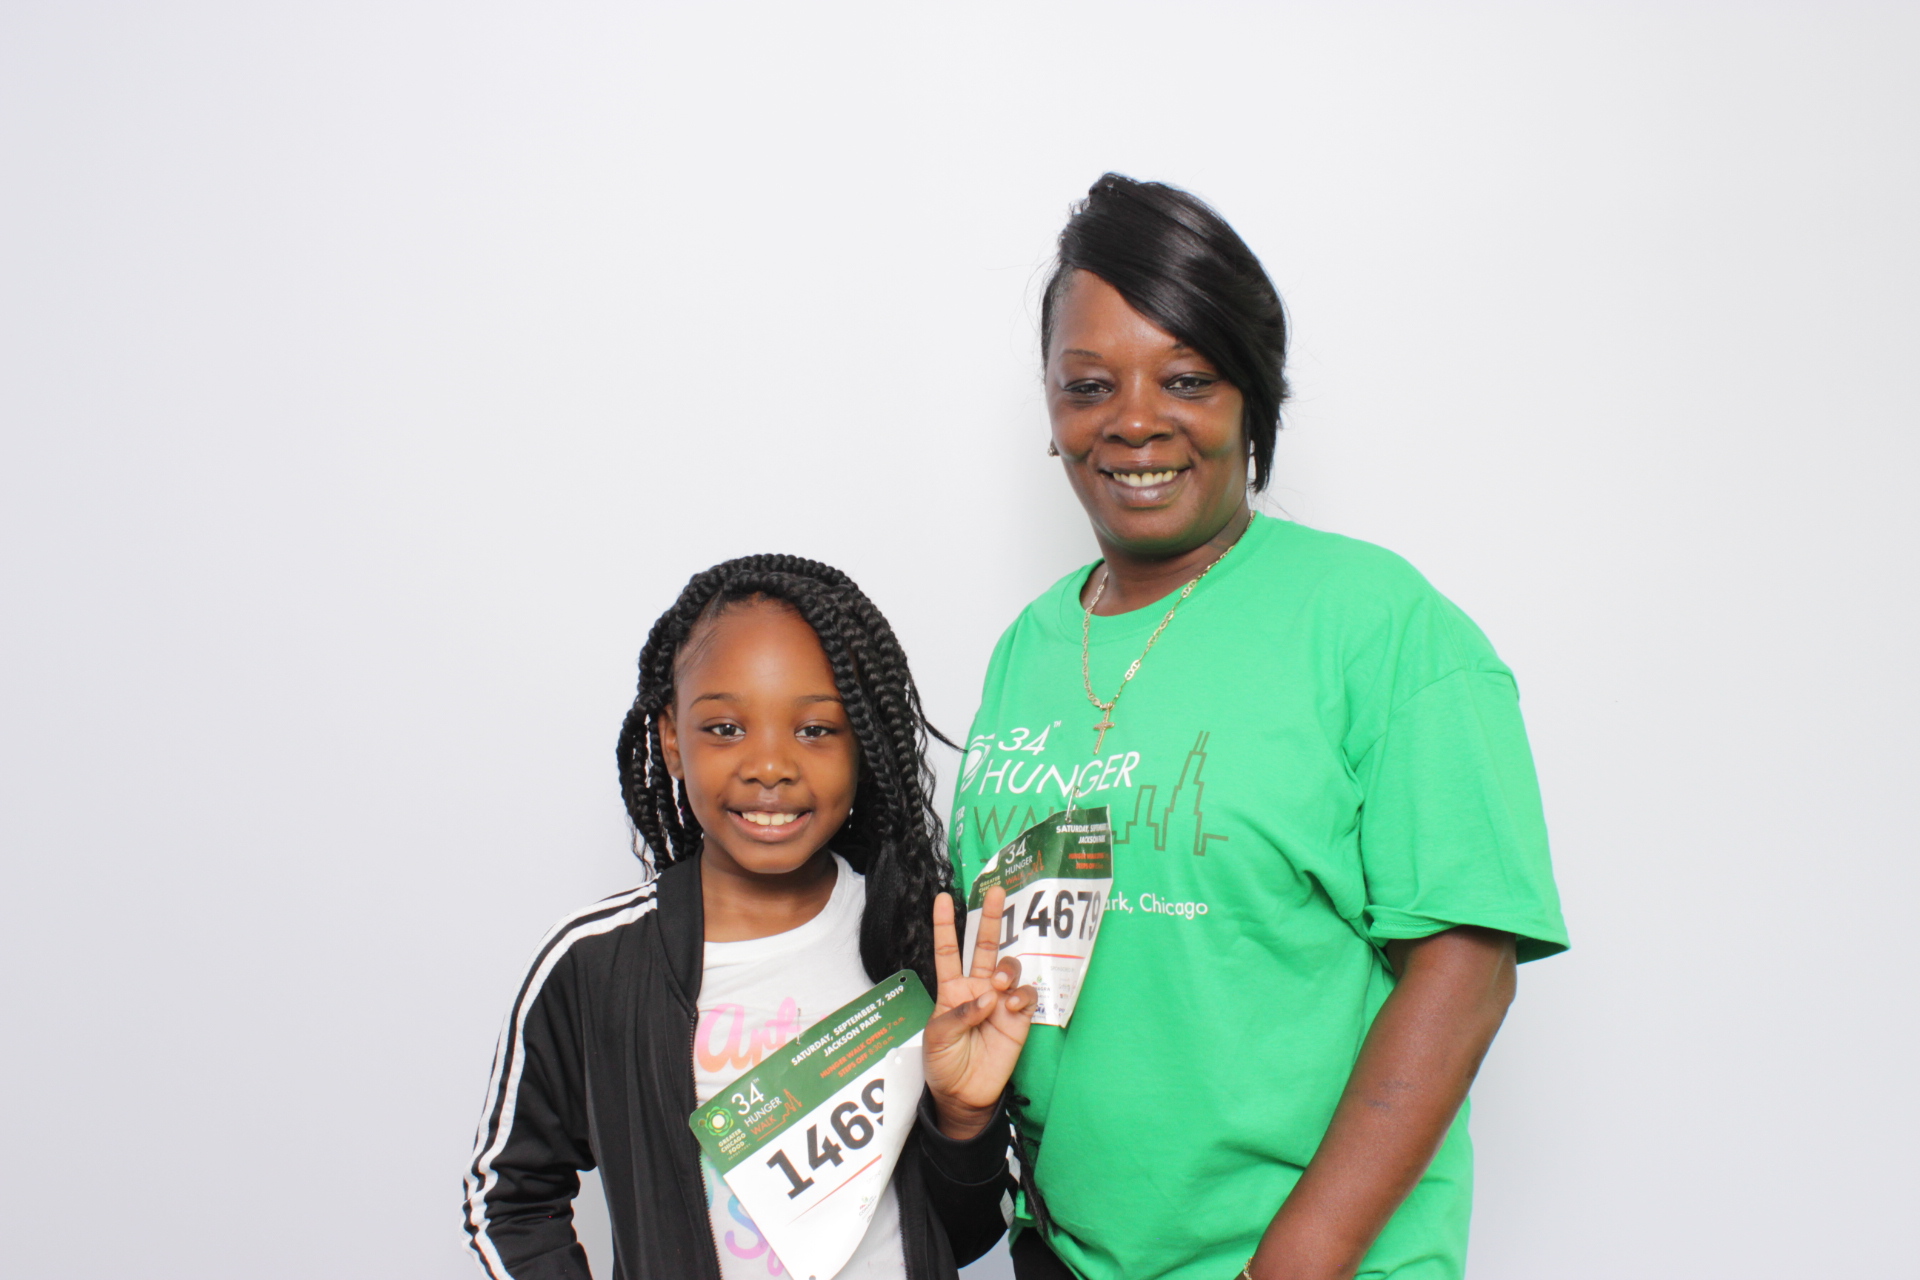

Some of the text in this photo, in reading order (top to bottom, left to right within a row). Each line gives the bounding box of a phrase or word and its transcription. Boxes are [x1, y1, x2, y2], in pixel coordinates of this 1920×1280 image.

[977, 751, 1140, 798] HUNGER
[974, 805, 1055, 846] WA
[1005, 855, 1033, 877] HUNGER
[999, 890, 1101, 951] 14679
[1103, 892, 1208, 920] ark, Chicago
[791, 985, 904, 1066] SATURDAY, SEPTEMBER 7, 2019
[823, 1012, 882, 1057] JACKSON PARK
[820, 1056, 848, 1079] HUNGER
[846, 1043, 867, 1059] WALK
[866, 1027, 888, 1045] OPENS
[838, 1062, 856, 1077] STEPS
[855, 1052, 868, 1064] OFF
[743, 1096, 782, 1127] HUNGER
[750, 1114, 777, 1135] WALK
[718, 1128, 742, 1147] GREATER
[720, 1133, 746, 1153] CHICAGO
[728, 1141, 745, 1155] FOOD
